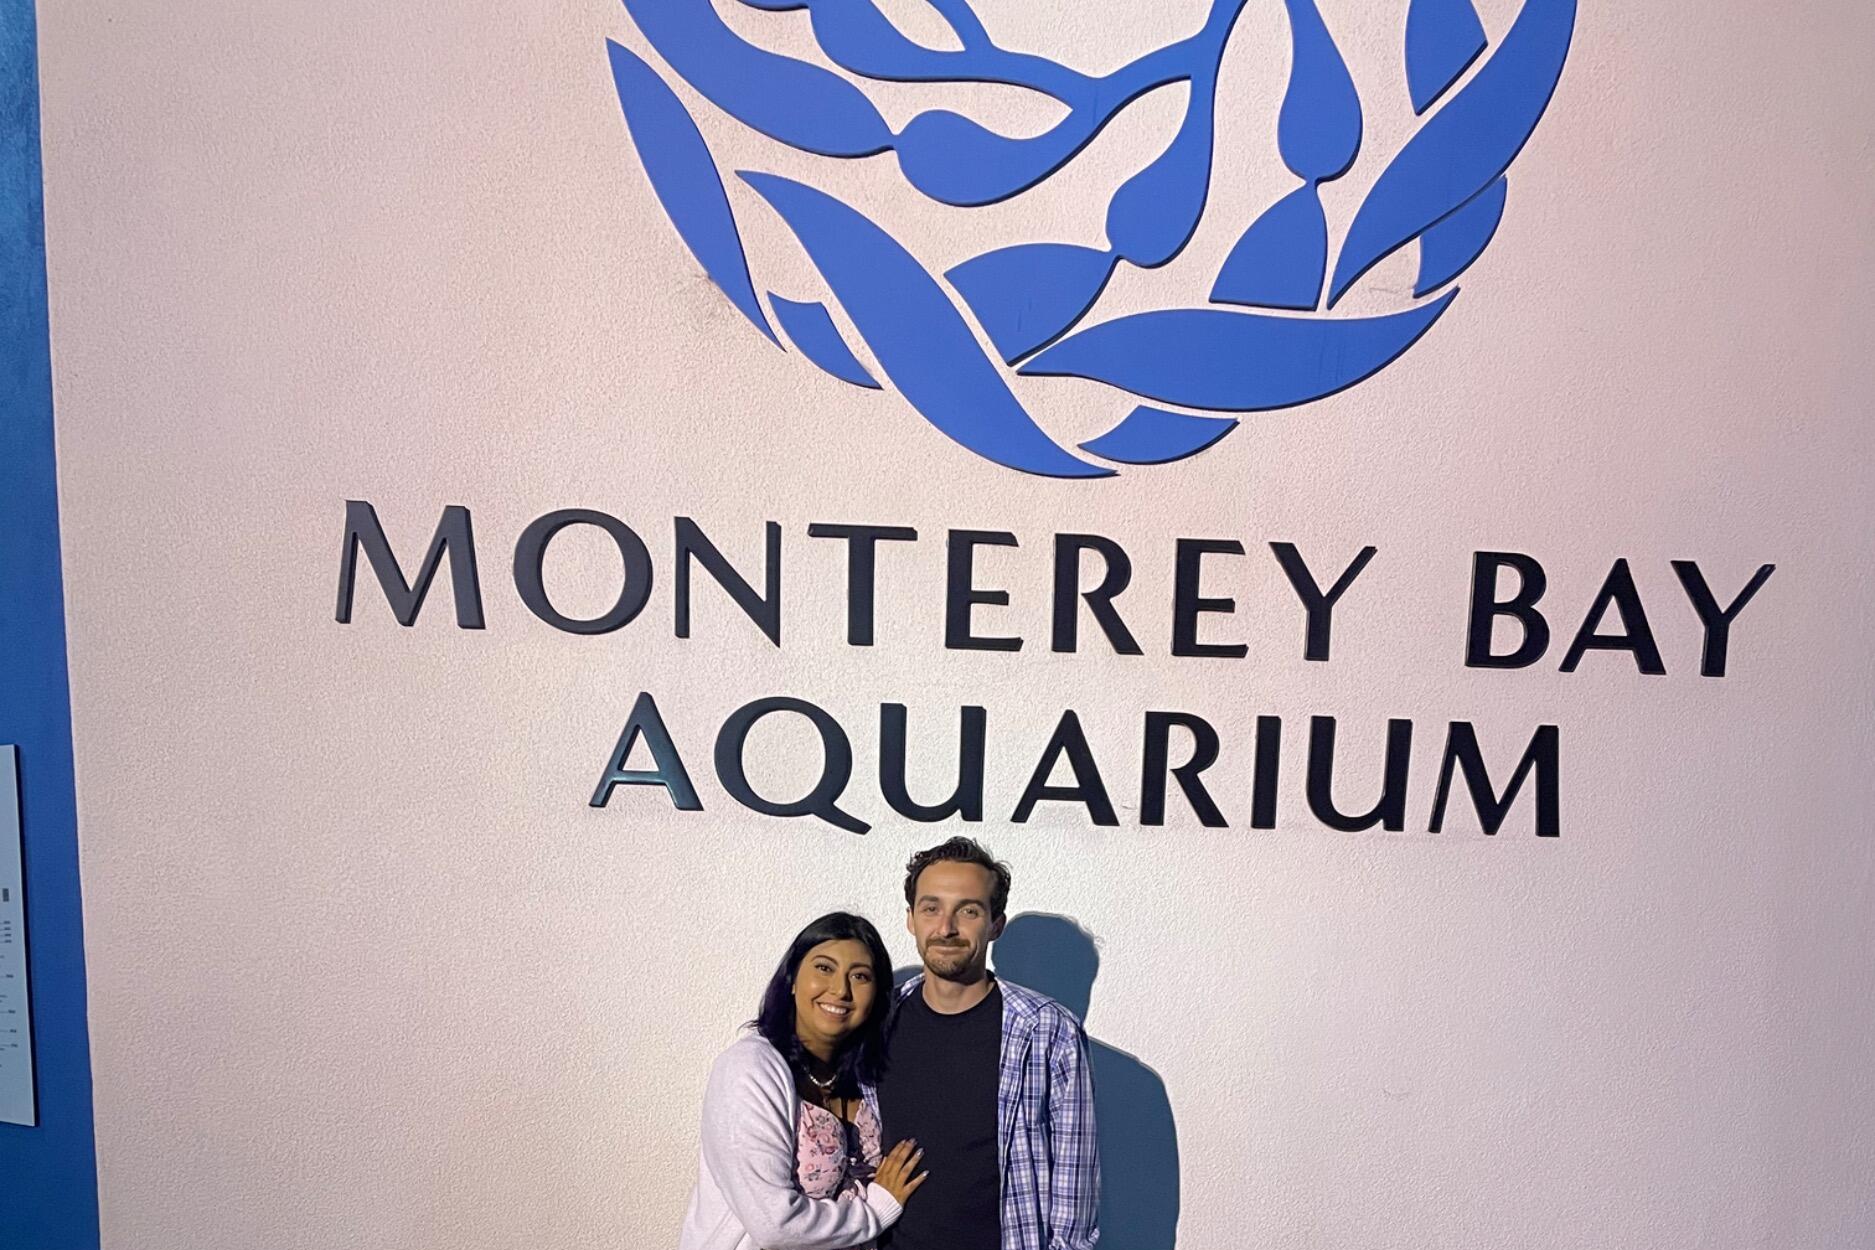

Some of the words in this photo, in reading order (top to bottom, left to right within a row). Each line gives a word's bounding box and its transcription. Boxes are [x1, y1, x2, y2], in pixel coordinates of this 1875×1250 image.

[335, 500, 1376, 661] MONTEREY
[1465, 551, 1776, 676] BAY
[589, 692, 1560, 836] AQUARIUM
